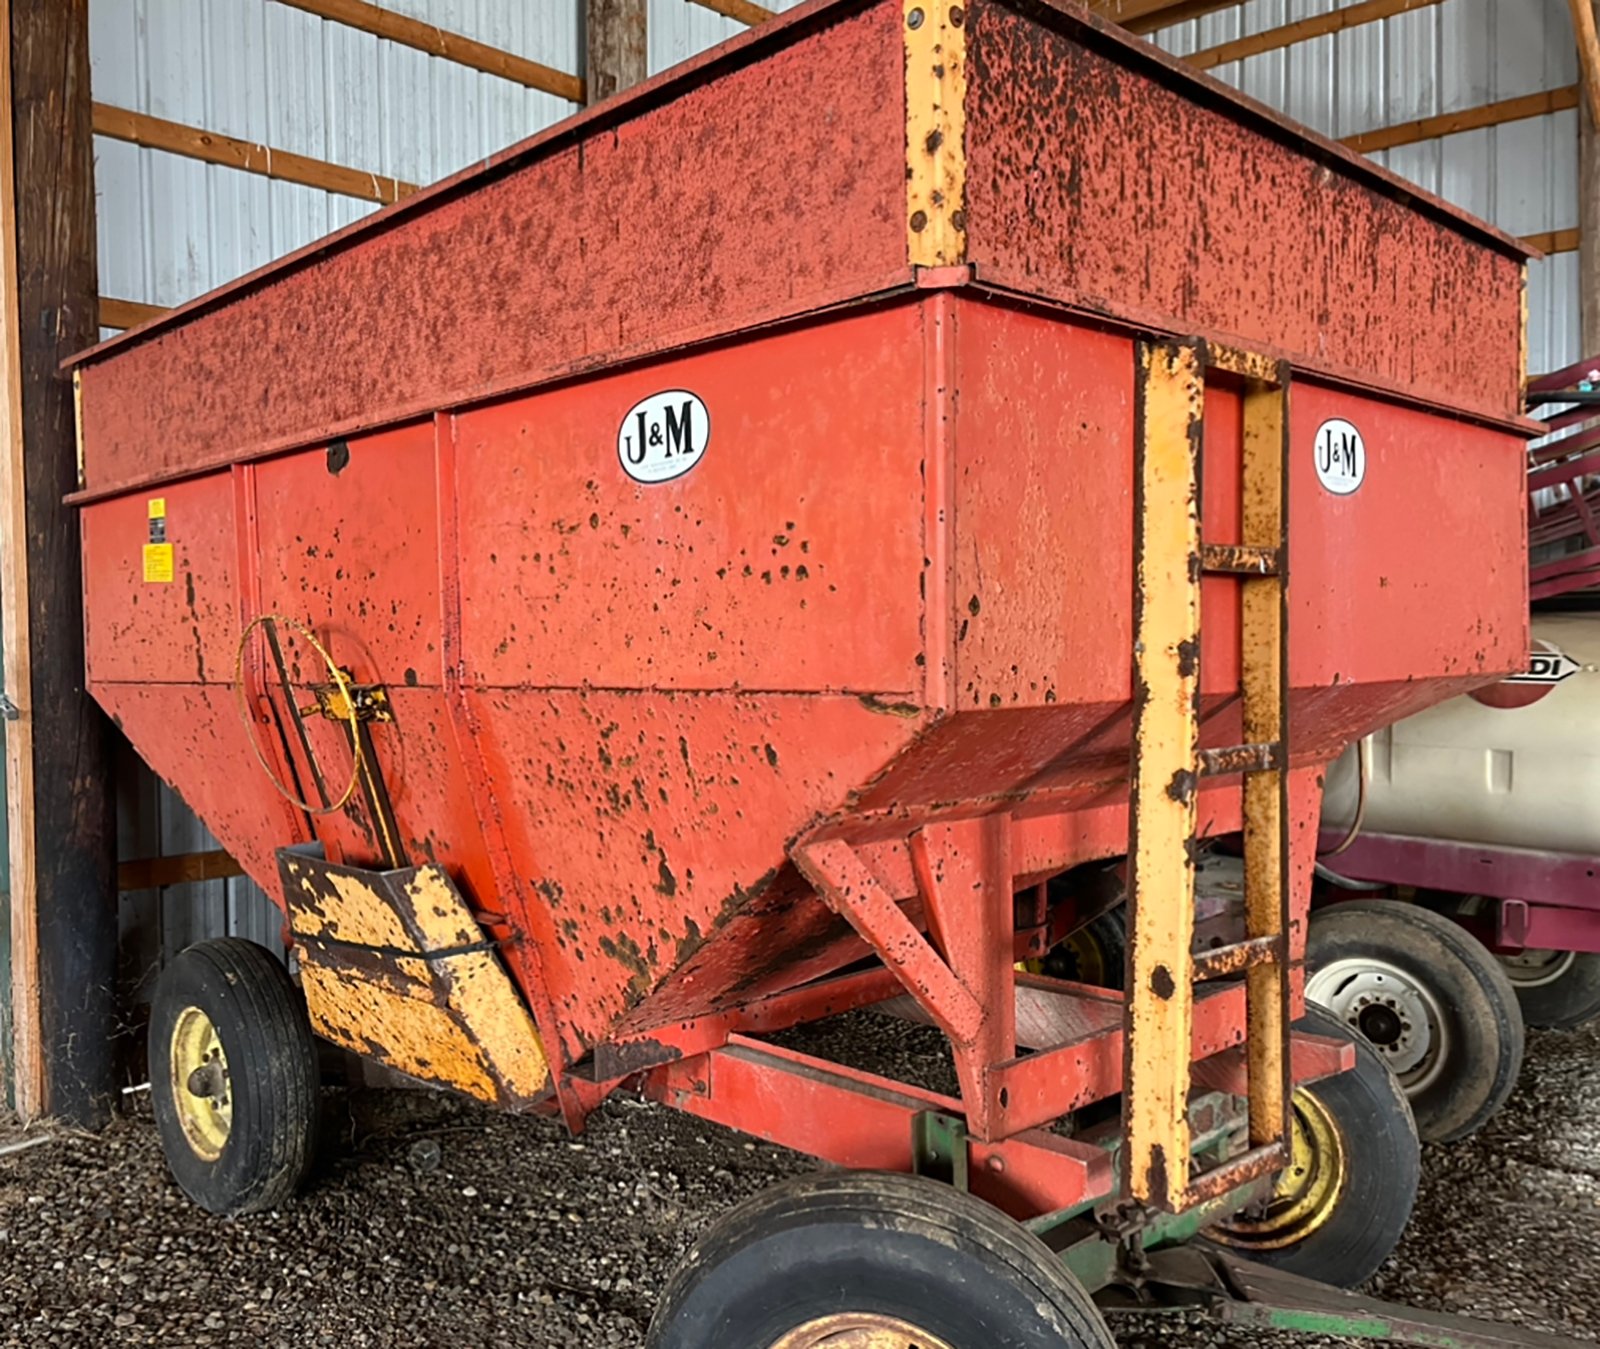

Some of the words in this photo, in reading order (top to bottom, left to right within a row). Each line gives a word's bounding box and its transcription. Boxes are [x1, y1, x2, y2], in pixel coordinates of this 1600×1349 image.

[624, 400, 694, 464] J&M
[1318, 429, 1357, 477] J&M
[1527, 659, 1561, 675] DI
